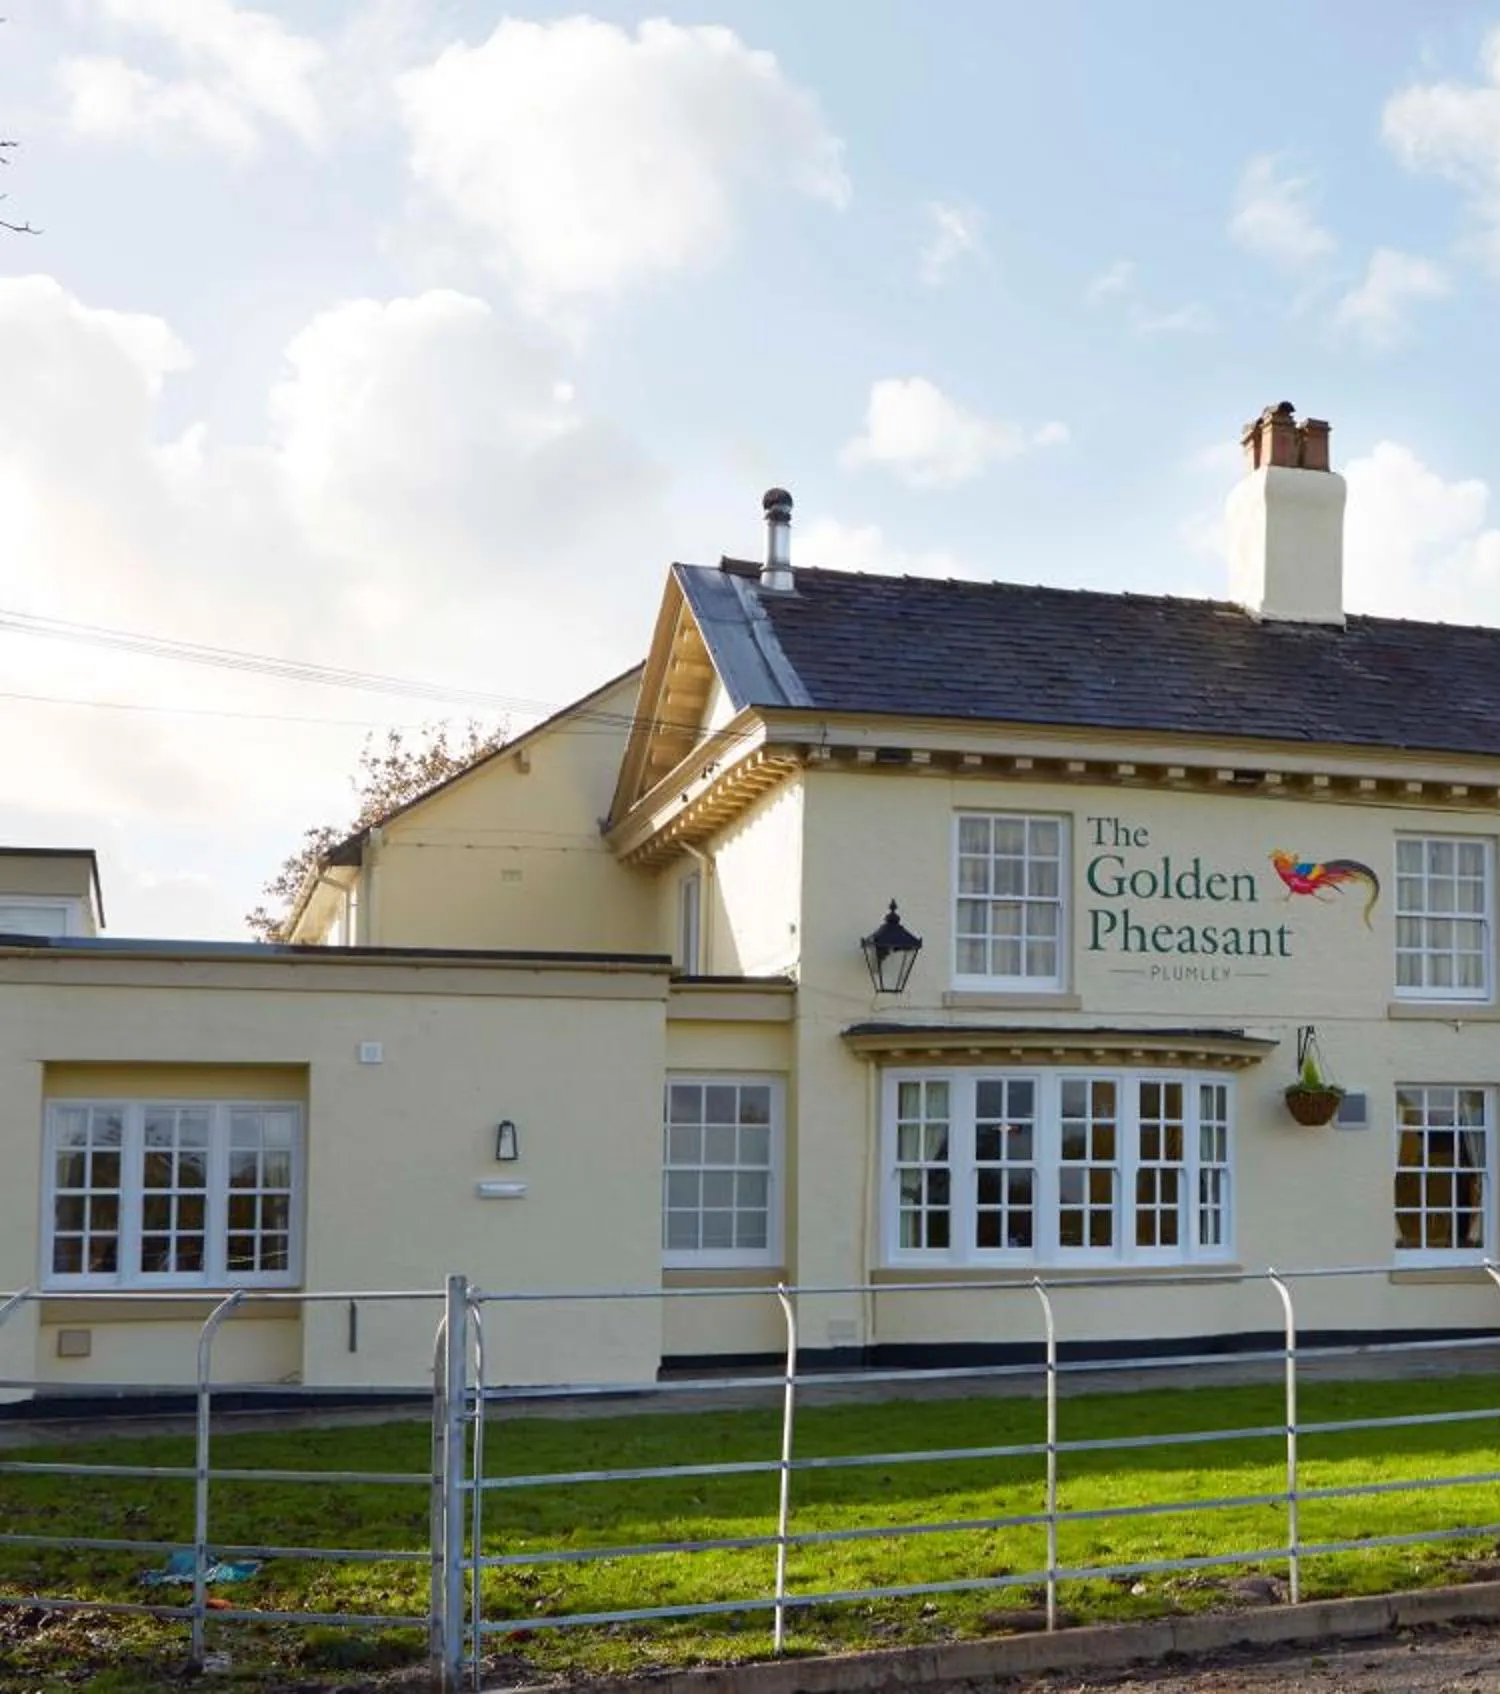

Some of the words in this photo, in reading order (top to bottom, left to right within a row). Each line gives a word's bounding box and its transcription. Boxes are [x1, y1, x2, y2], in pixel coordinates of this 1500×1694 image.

[1087, 817, 1149, 848] The
[1087, 855, 1257, 901] Golden
[1087, 908, 1293, 957] Pheasant
[1151, 965, 1231, 981] PLUMLEY
